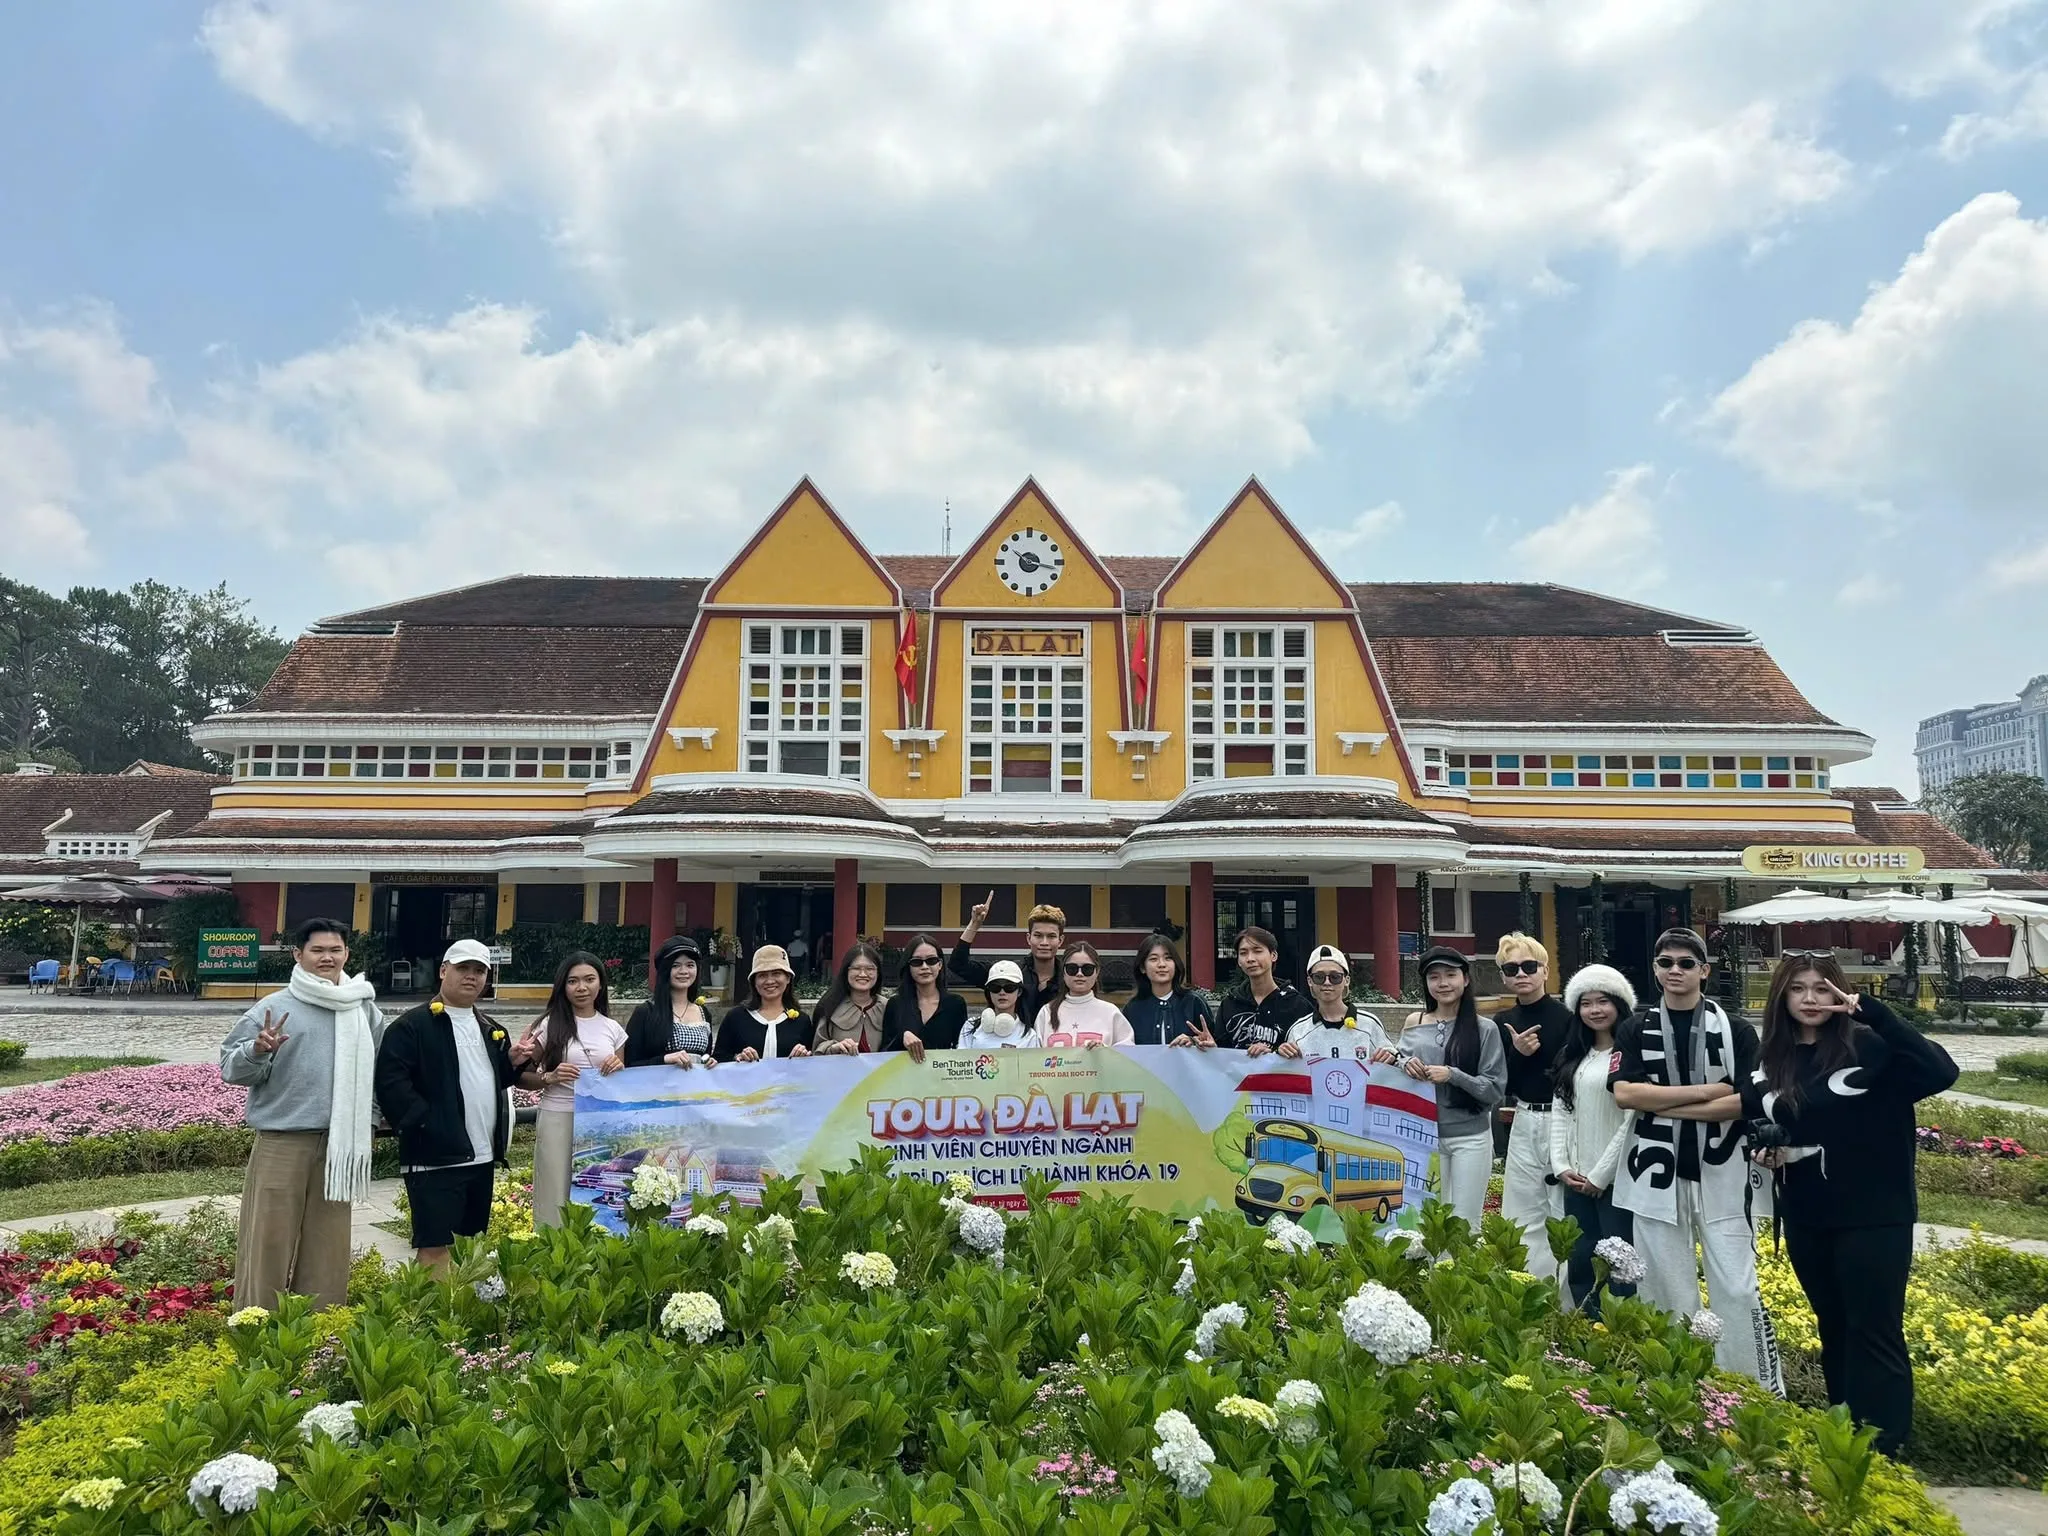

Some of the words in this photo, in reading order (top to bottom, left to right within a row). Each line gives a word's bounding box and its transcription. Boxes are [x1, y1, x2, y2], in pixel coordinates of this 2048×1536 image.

[1801, 852, 1843, 868] KING
[1846, 852, 1908, 869] COFFEE
[202, 933, 256, 942] SHOWROOM
[208, 945, 249, 957] COFFEE
[1331, 1046, 1339, 1059] 8
[947, 1068, 974, 1076] Tourist
[867, 1096, 984, 1140] TOUR
[992, 1083, 1058, 1135] ĐÀ
[1063, 1091, 1145, 1136] LẠT
[931, 1138, 975, 1159] VIÊN
[980, 1136, 1056, 1157] CHUYÊN
[1061, 1132, 1133, 1155] NGÀNH
[1096, 1160, 1152, 1181] KHÓA
[1158, 1163, 1178, 1180] 19
